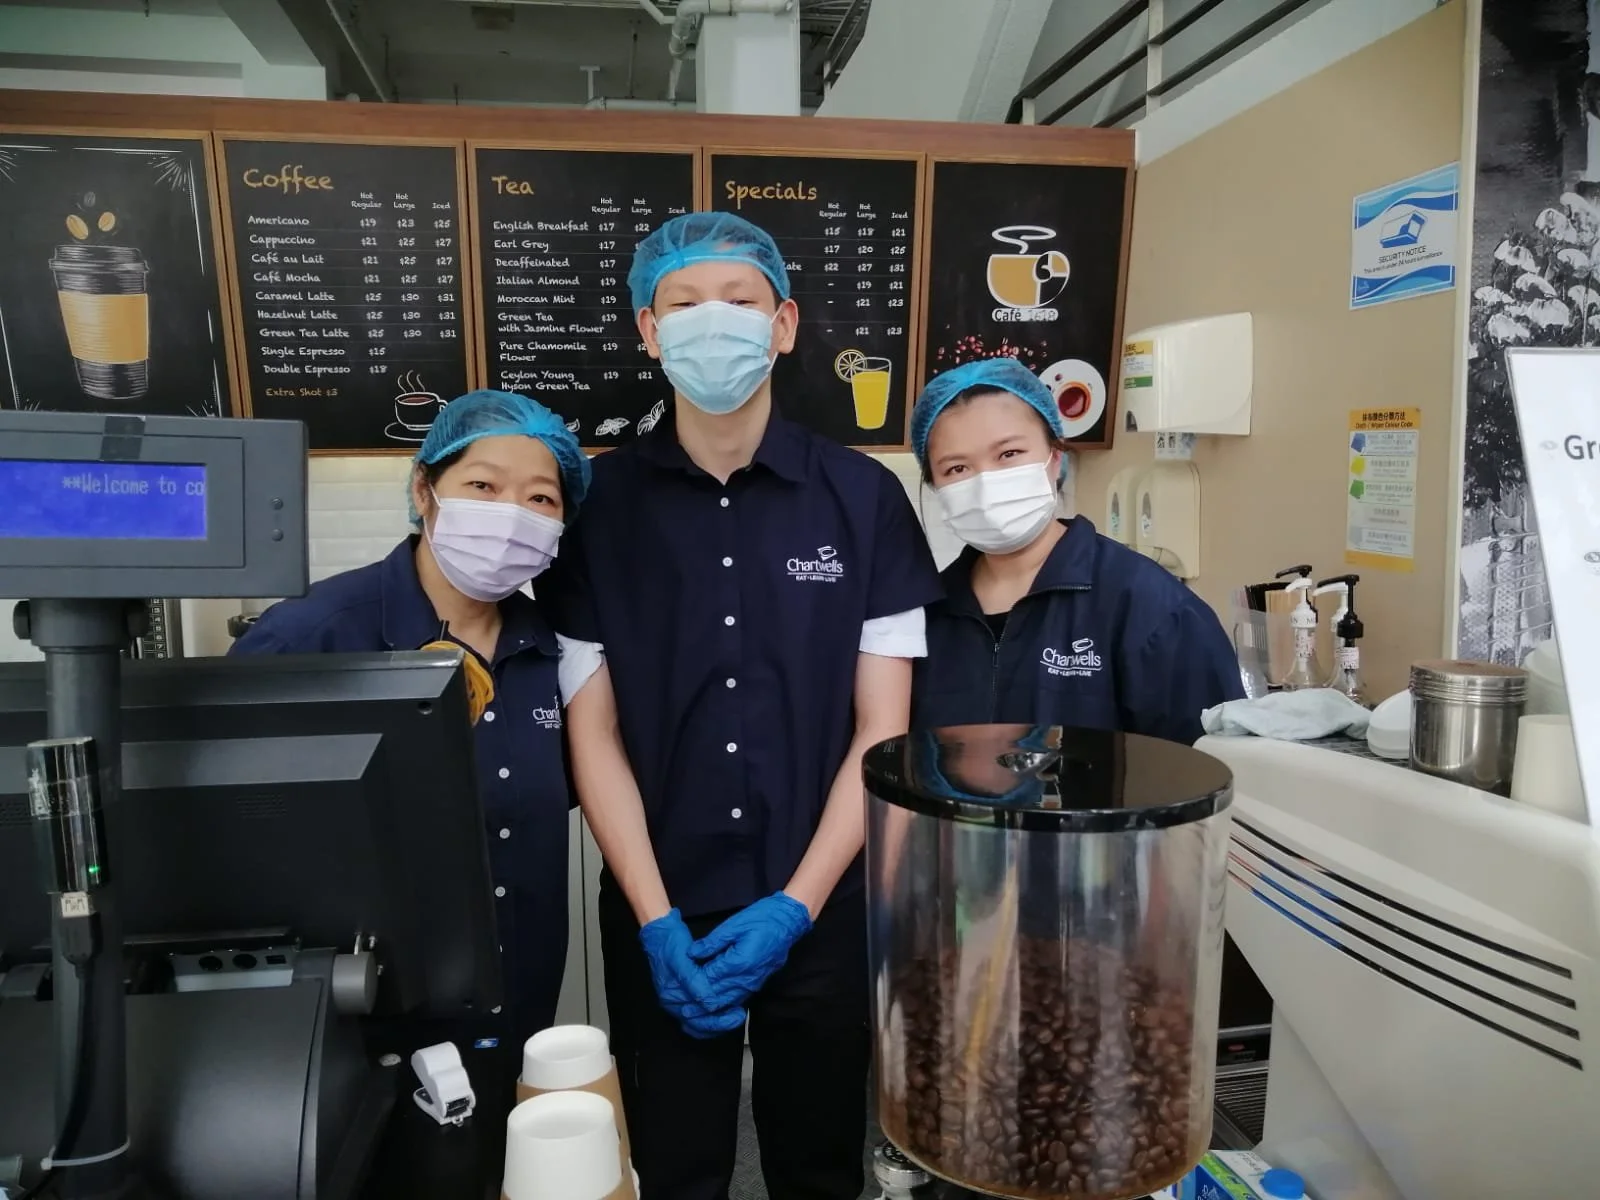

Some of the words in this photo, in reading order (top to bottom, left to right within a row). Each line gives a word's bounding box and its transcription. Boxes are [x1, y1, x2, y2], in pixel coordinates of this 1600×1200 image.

[243, 164, 334, 194] Coffee
[491, 176, 534, 195] Tea
[725, 180, 817, 210] Specials
[351, 201, 382, 210] Regular
[394, 201, 416, 211] Large
[592, 206, 621, 214] Regular
[631, 207, 652, 215] Large
[819, 211, 847, 219] Regular
[857, 211, 876, 220] Large
[247, 216, 310, 226] Americano
[360, 218, 377, 228] $19
[397, 219, 415, 228] $23
[493, 221, 533, 232] English
[537, 222, 589, 232] Breakfast
[599, 222, 615, 232] $17
[249, 234, 316, 249] Cappuccino
[361, 238, 377, 247] $21
[436, 239, 452, 248] $27
[494, 240, 517, 249] Earl
[521, 240, 549, 253] Grey
[599, 241, 616, 250] $17
[1406, 245, 1426, 256] NOTICE
[251, 252, 279, 264] Café
[302, 254, 324, 264] Lait
[362, 256, 379, 265] $21
[436, 257, 453, 266] $27
[494, 257, 570, 269] Decaffeinated
[599, 260, 616, 268] $17
[253, 271, 281, 283] Café
[286, 273, 321, 282] Mocha
[364, 275, 380, 284] $21
[437, 275, 454, 284] $27
[496, 276, 534, 285] Italian
[537, 276, 580, 286] Almond
[600, 278, 616, 287] $19
[255, 291, 303, 301] Caramel
[307, 292, 335, 301] Latte
[497, 295, 548, 304] Moroccan
[552, 295, 575, 304] Mint
[600, 296, 617, 305] $19
[257, 310, 306, 320] Hazelnut
[310, 310, 338, 320] Latte
[497, 312, 532, 322] Green
[535, 313, 554, 322] Tea
[601, 313, 617, 322] $19
[259, 328, 295, 338] Green
[299, 328, 318, 337] Tea
[322, 328, 350, 338] Latte
[498, 324, 520, 333] with
[523, 324, 566, 333] Jasmine
[569, 325, 604, 333] Flower
[500, 342, 524, 351] Pure
[527, 342, 587, 351] Chamomile
[602, 342, 618, 352] $19
[636, 343, 647, 351] $2
[261, 346, 294, 358] Single
[299, 347, 345, 360] Espresso
[500, 353, 536, 362] Flower
[263, 364, 300, 374] Double
[305, 365, 350, 378] Espresso
[500, 370, 539, 383] Ceylon
[541, 370, 575, 382] Young
[604, 371, 619, 380] $19
[265, 388, 295, 396] Extra
[300, 388, 322, 396] Shot
[501, 382, 532, 393] Hyson
[536, 382, 569, 390] Green
[573, 382, 590, 390] Tea
[1564, 434, 1600, 460] Gr
[159, 475, 177, 495] to
[787, 557, 843, 573] Chartwells
